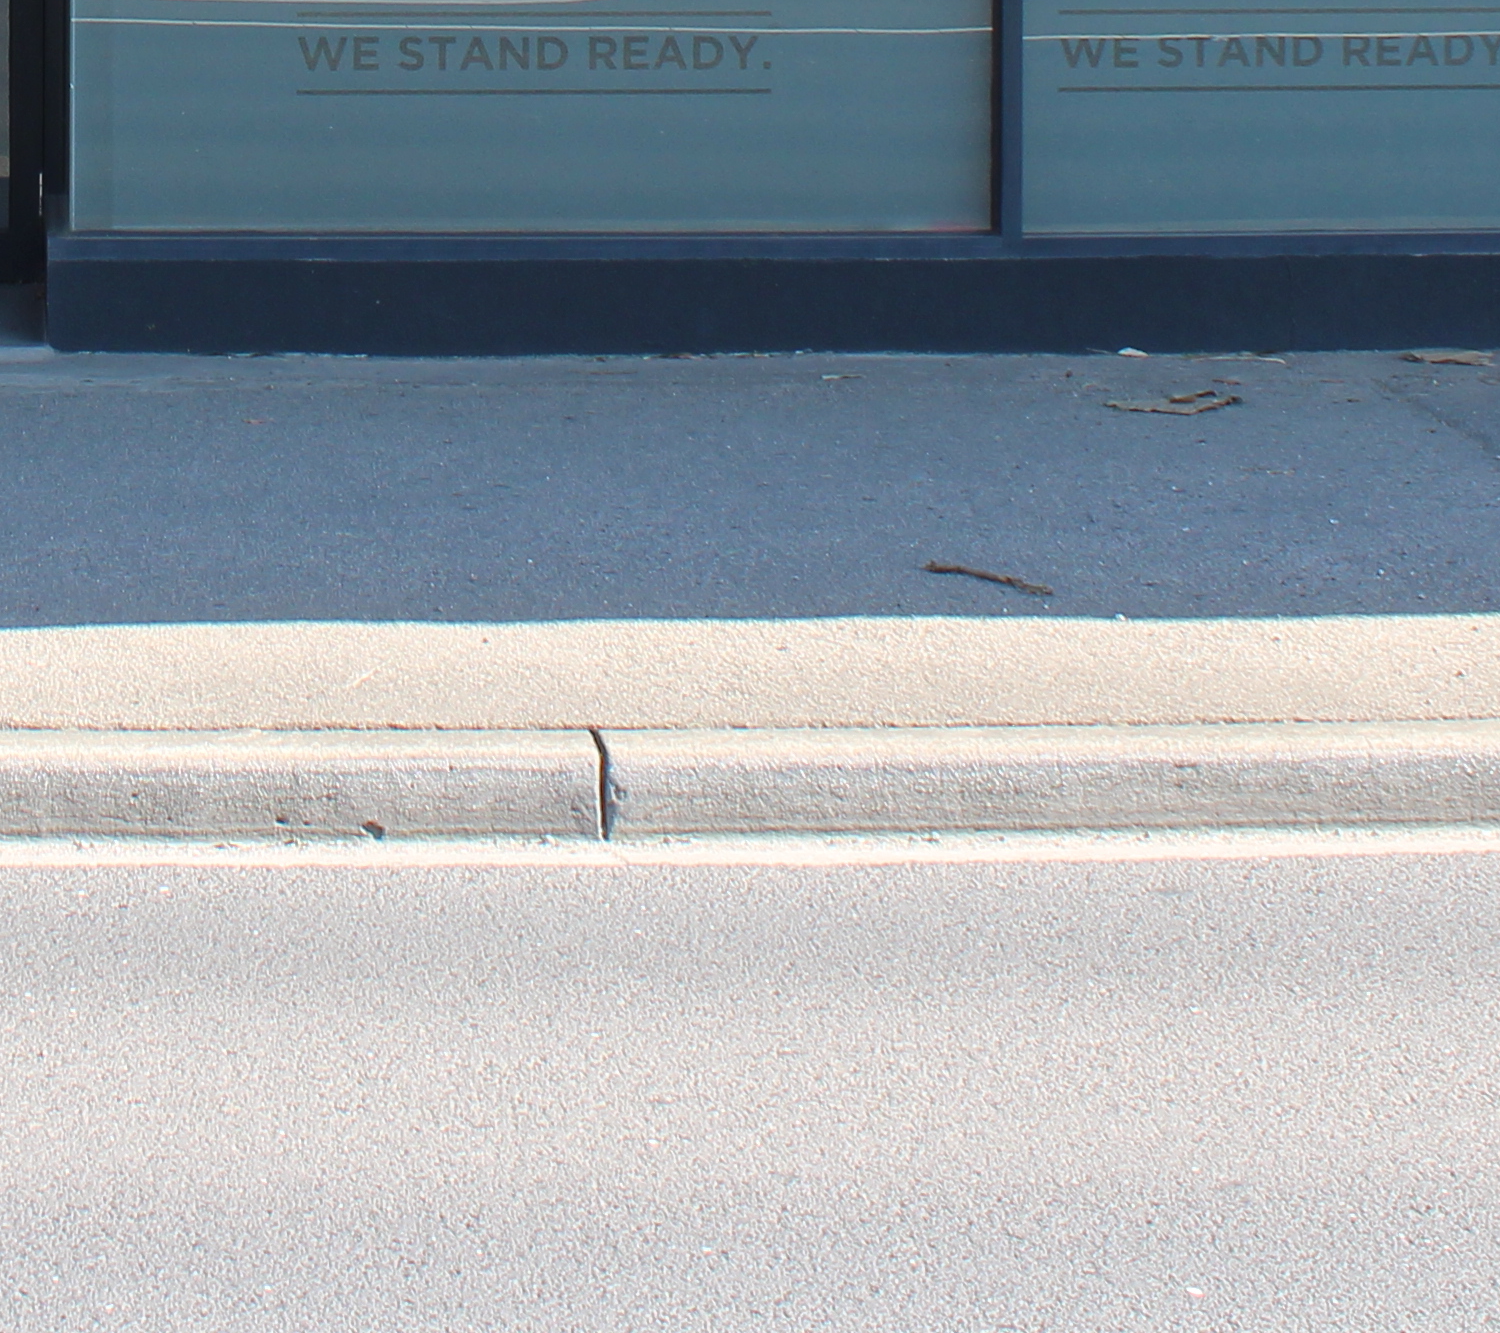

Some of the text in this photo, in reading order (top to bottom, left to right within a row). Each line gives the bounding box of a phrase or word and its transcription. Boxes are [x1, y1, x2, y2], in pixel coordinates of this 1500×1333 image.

[298, 36, 773, 73] WE STAND READY.
[1060, 36, 1142, 69] WE
[1157, 36, 1325, 69] STAND
